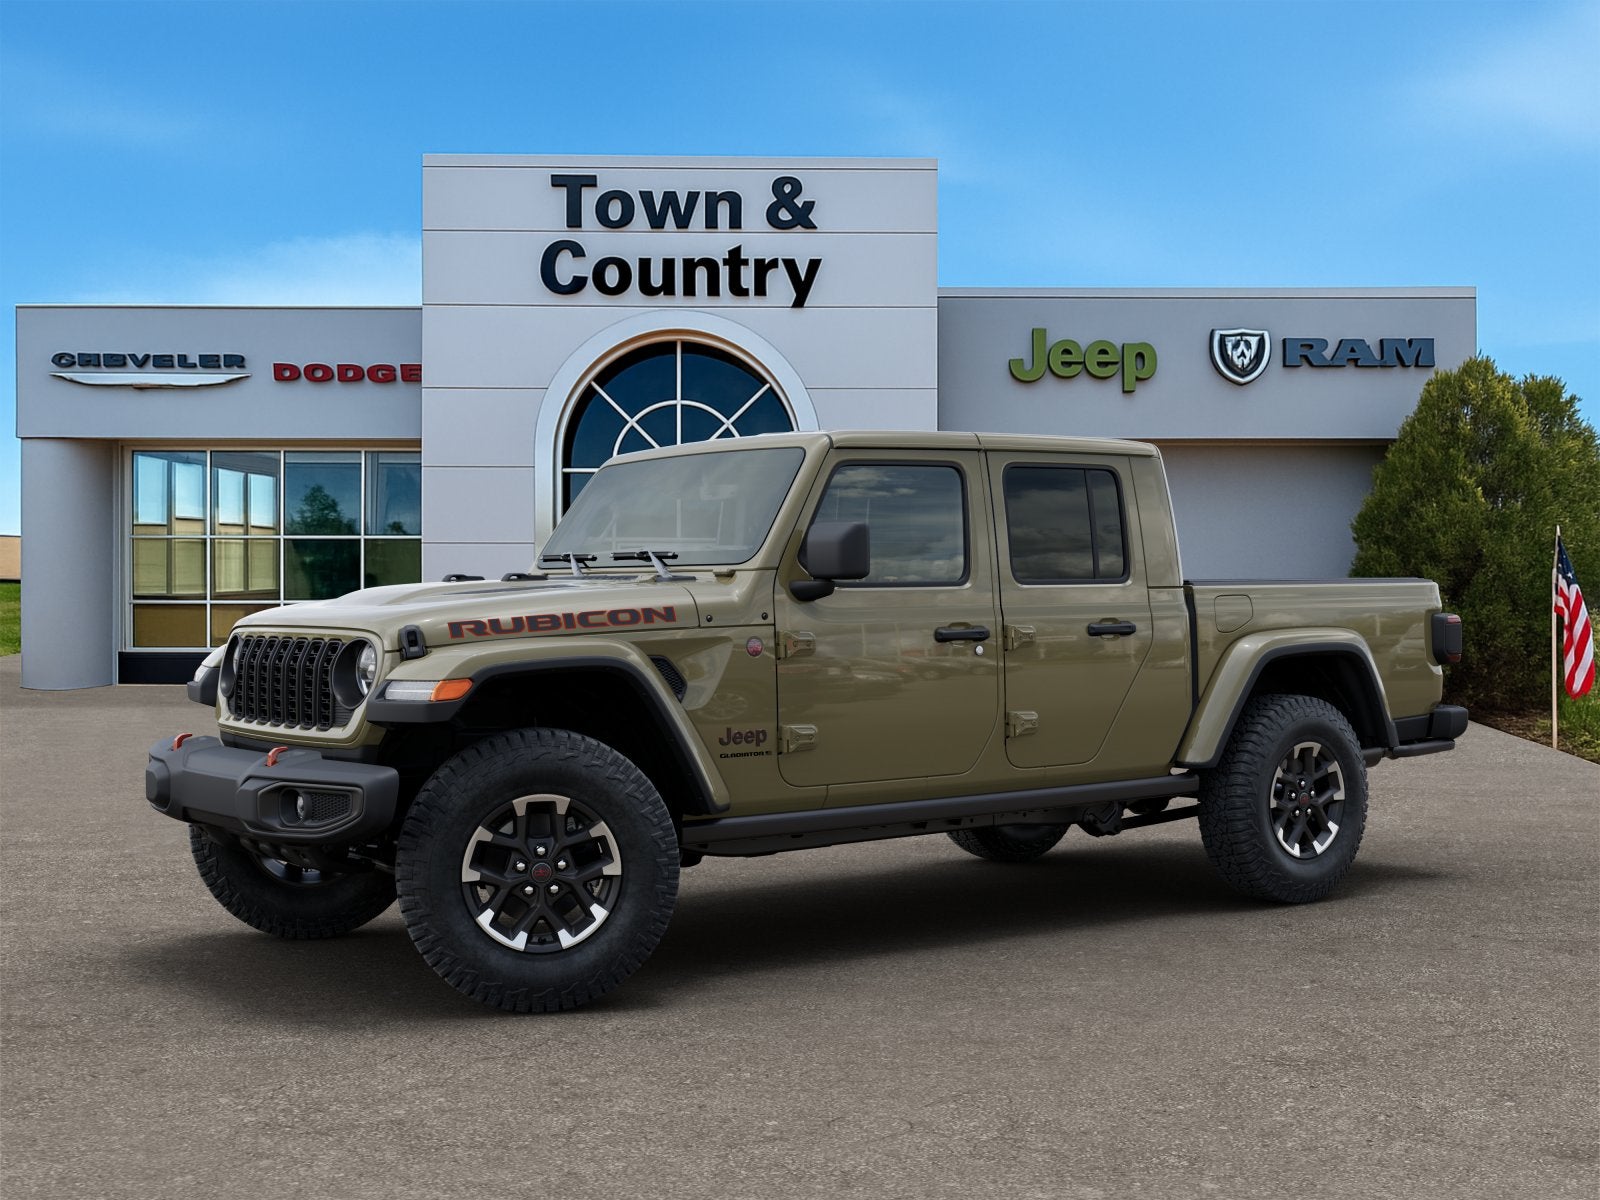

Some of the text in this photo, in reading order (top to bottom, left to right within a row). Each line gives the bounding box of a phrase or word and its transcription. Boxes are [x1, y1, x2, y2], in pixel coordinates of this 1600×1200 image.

[550, 174, 818, 230] Town &
[540, 239, 822, 308] Country
[1009, 328, 1158, 393] Jeep
[1282, 337, 1435, 368] RAM
[273, 362, 422, 383] DODGE
[447, 606, 677, 639] RUBICON
[718, 727, 768, 747] Jeep
